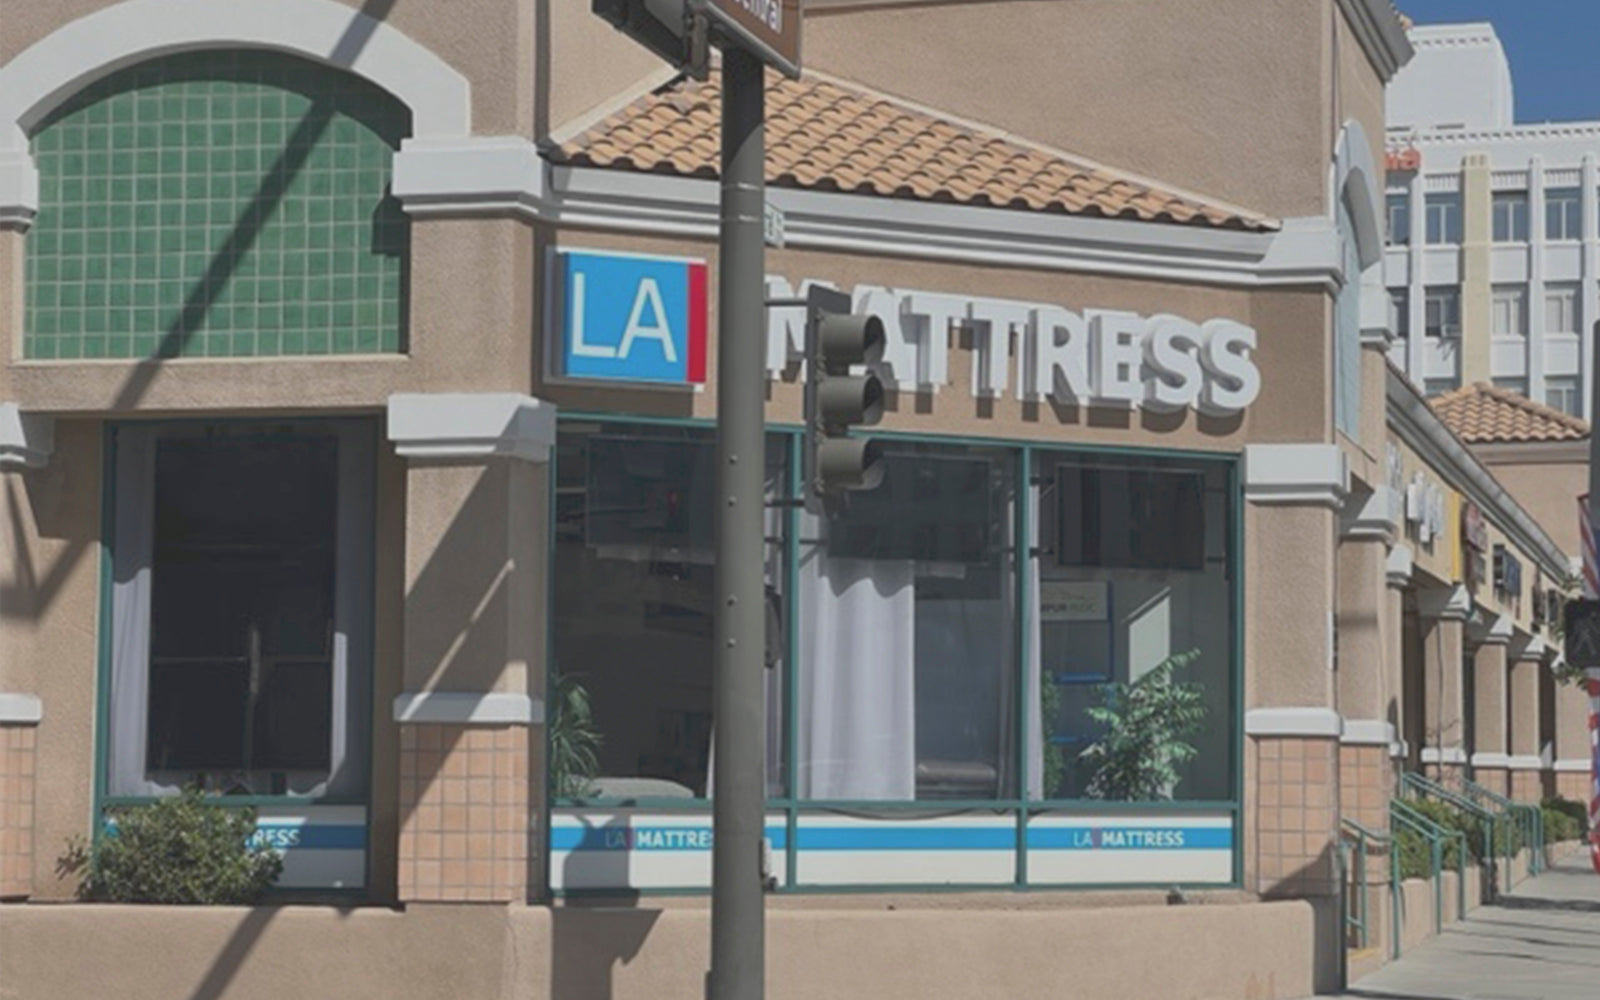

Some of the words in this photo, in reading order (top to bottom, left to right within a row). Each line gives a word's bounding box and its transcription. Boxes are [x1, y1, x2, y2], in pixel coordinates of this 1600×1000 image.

[572, 272, 678, 363] LA
[763, 274, 1262, 411] MATTRESS
[1073, 831, 1093, 847] LA
[1101, 830, 1184, 847] MATTRESS
